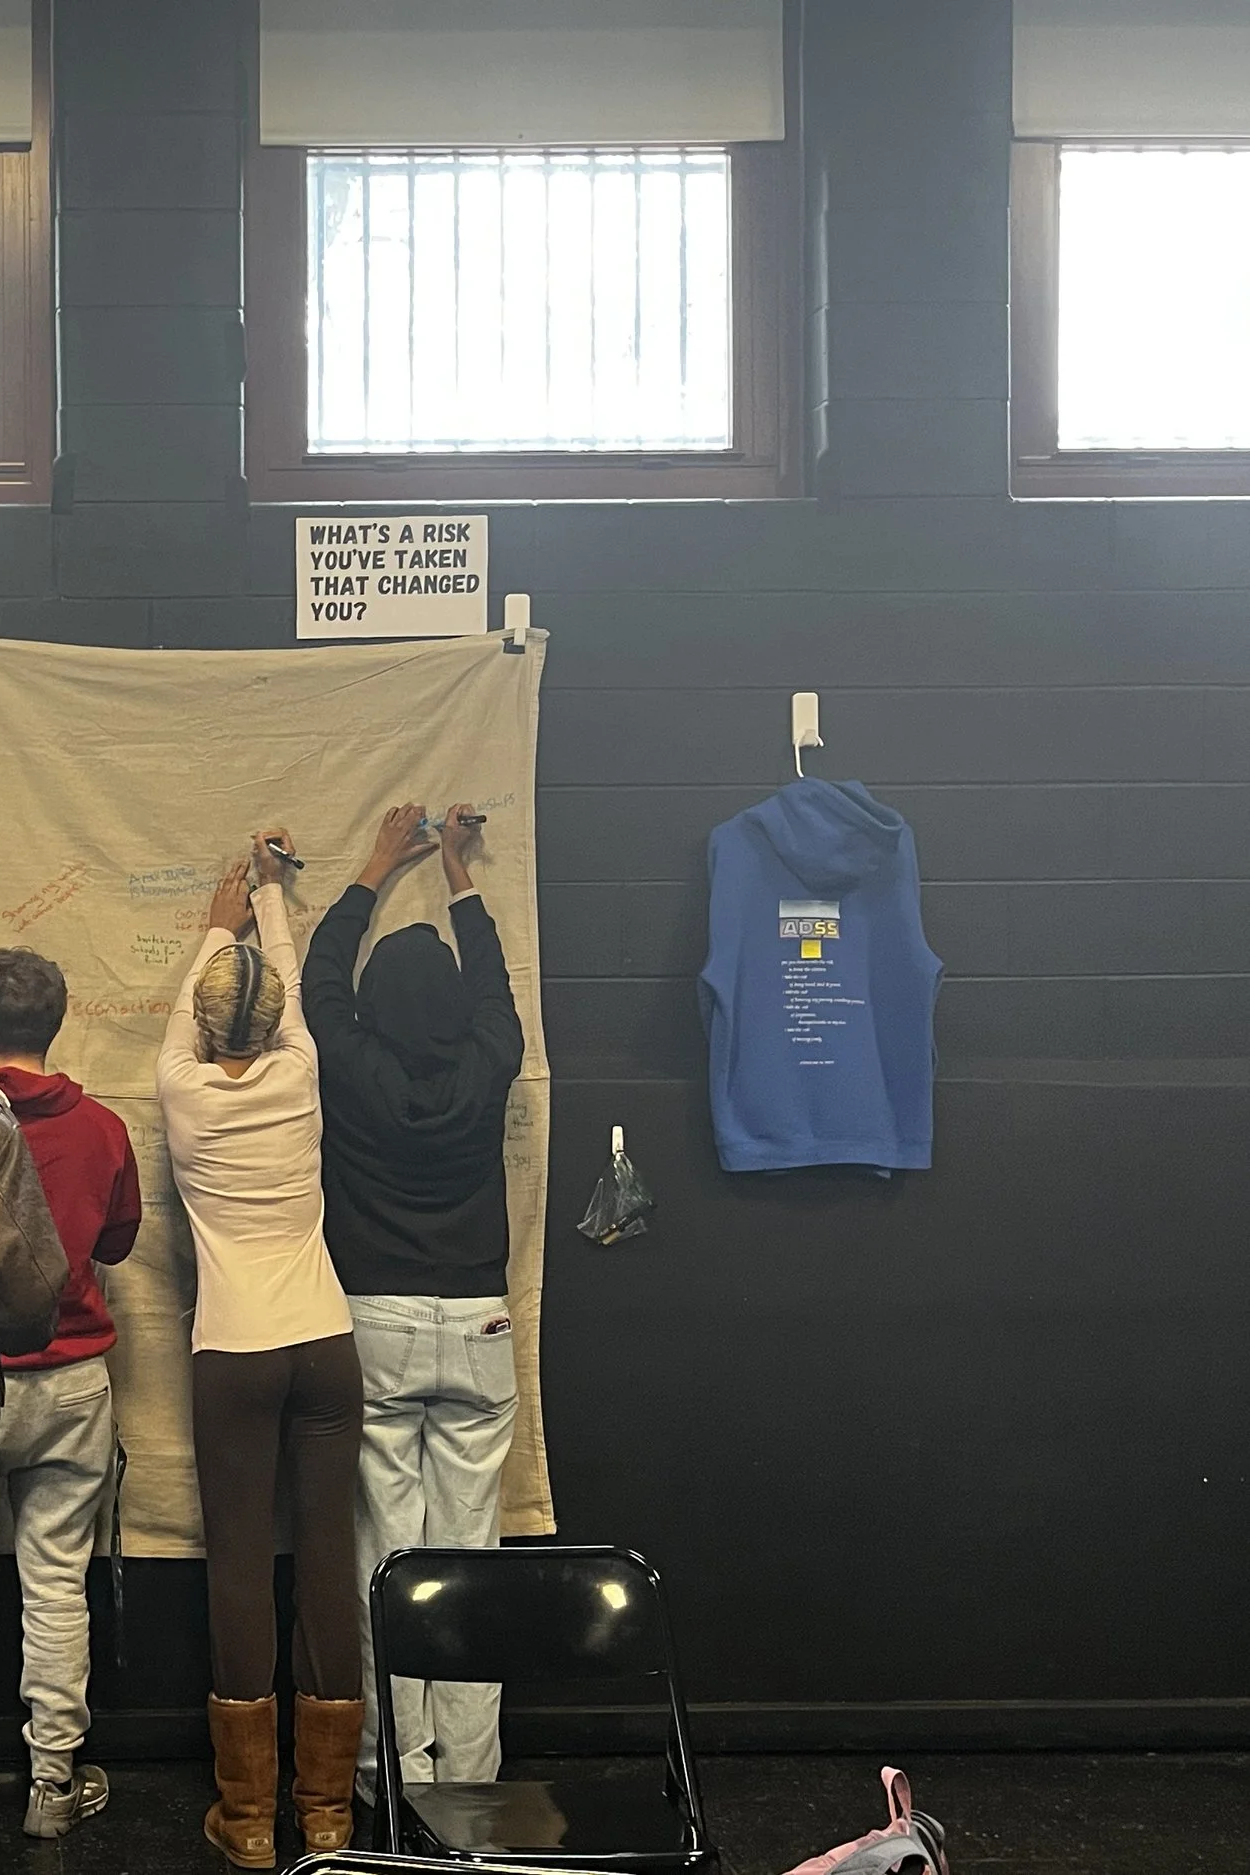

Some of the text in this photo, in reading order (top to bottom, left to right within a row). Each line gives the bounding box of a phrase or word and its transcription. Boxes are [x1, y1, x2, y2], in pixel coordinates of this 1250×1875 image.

[310, 523, 470, 544] WHAT'S A RISK
[311, 549, 466, 570] YOU'VE TAKEN
[311, 575, 479, 596] THAT CHANGED
[311, 602, 367, 621] YOU?
[783, 921, 838, 936] ADSS
